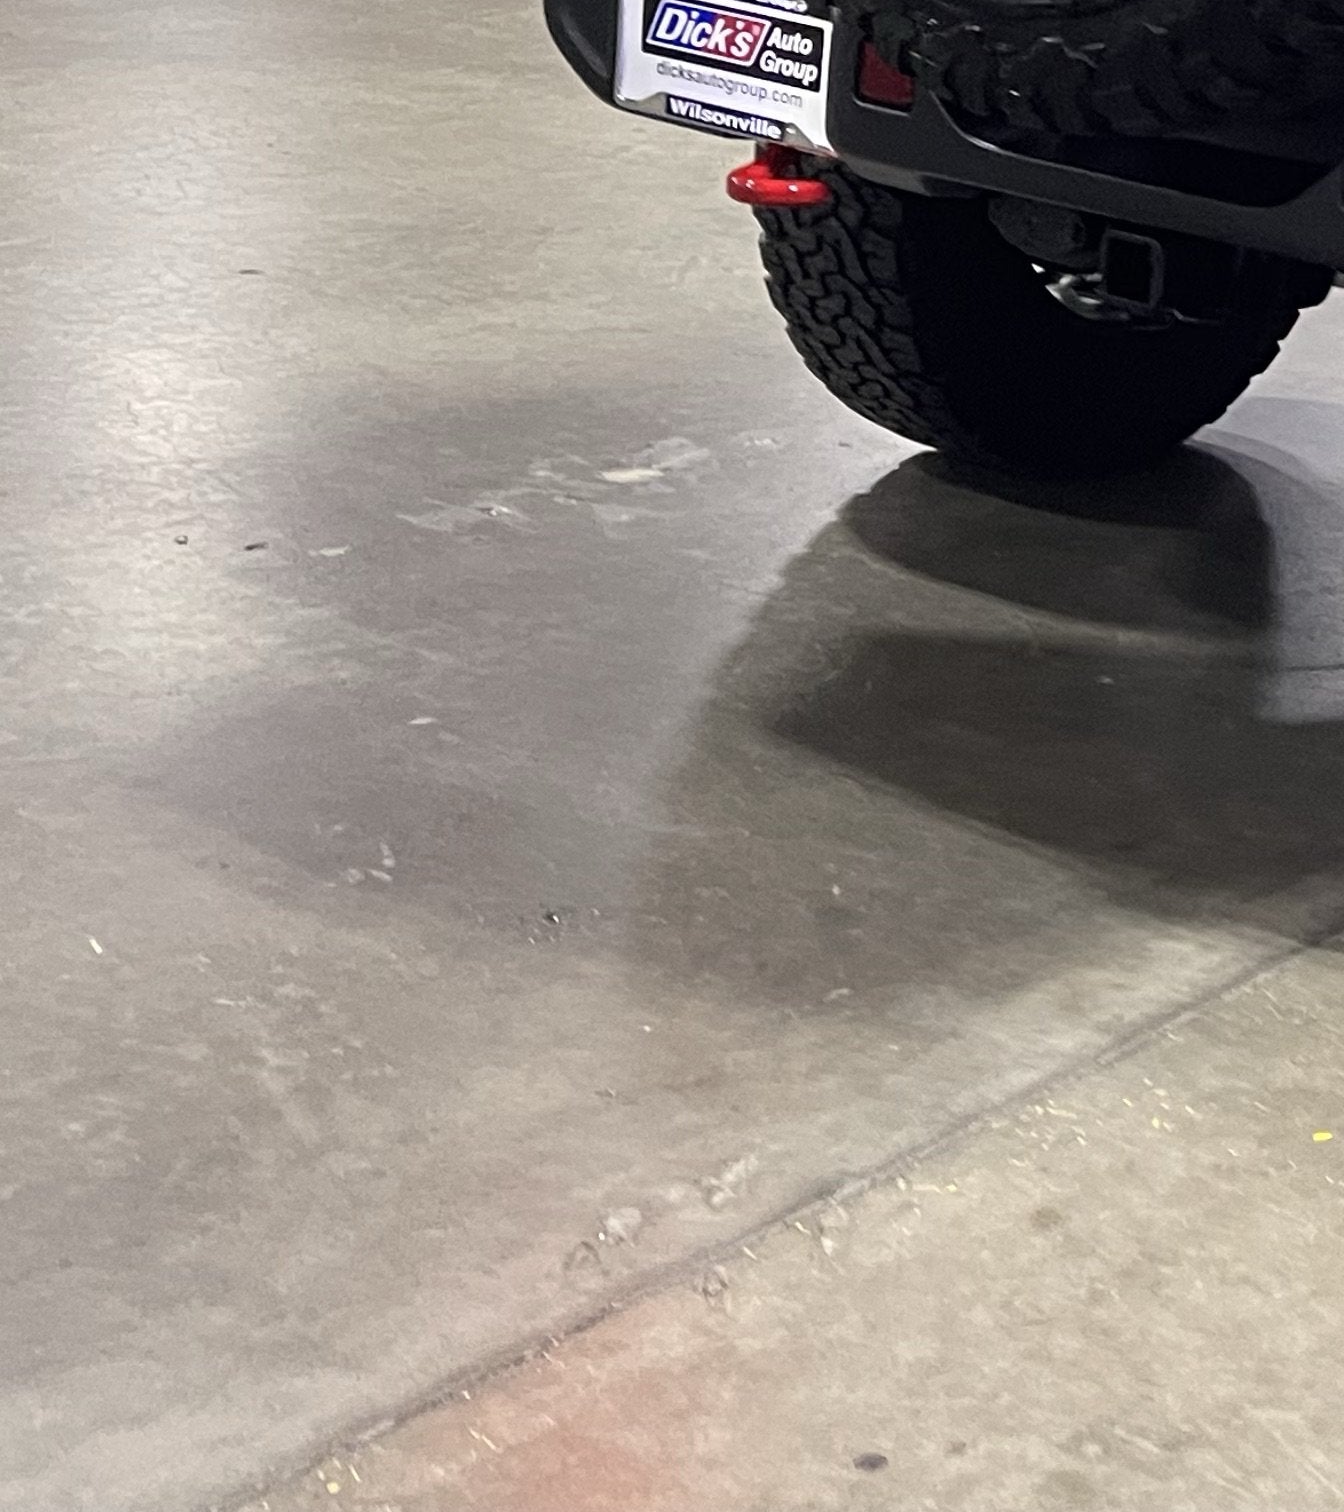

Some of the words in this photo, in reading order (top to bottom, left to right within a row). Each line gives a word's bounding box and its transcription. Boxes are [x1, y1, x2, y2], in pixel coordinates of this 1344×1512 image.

[766, 26, 814, 56] Auto
[759, 49, 819, 87] Group
[668, 96, 782, 140] Wilsonville
